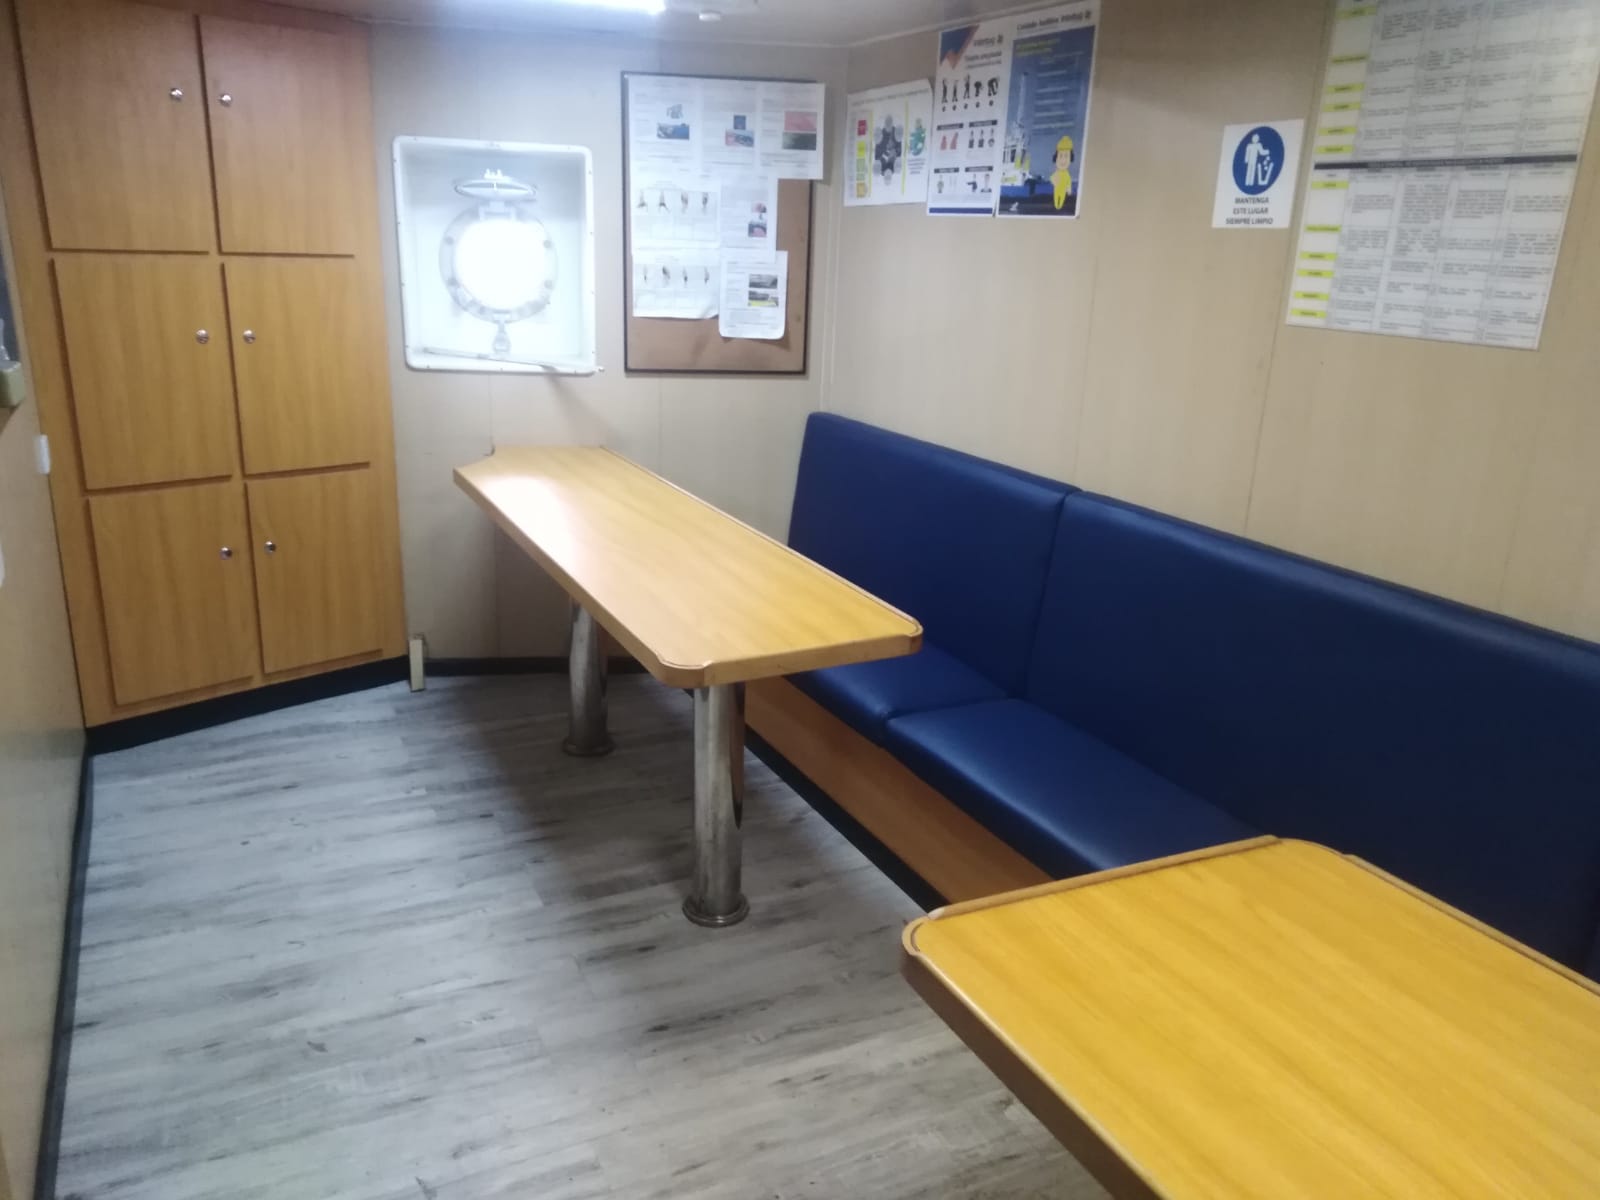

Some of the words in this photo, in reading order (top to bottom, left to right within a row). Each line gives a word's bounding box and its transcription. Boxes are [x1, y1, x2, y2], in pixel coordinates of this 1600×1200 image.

[1234, 196, 1269, 204] MANTENGA
[1232, 207, 1247, 215] ESTE
[1247, 207, 1268, 215] LUGAR
[1225, 217, 1250, 225] SIEMPRE
[1251, 217, 1273, 225] LIMPIO
